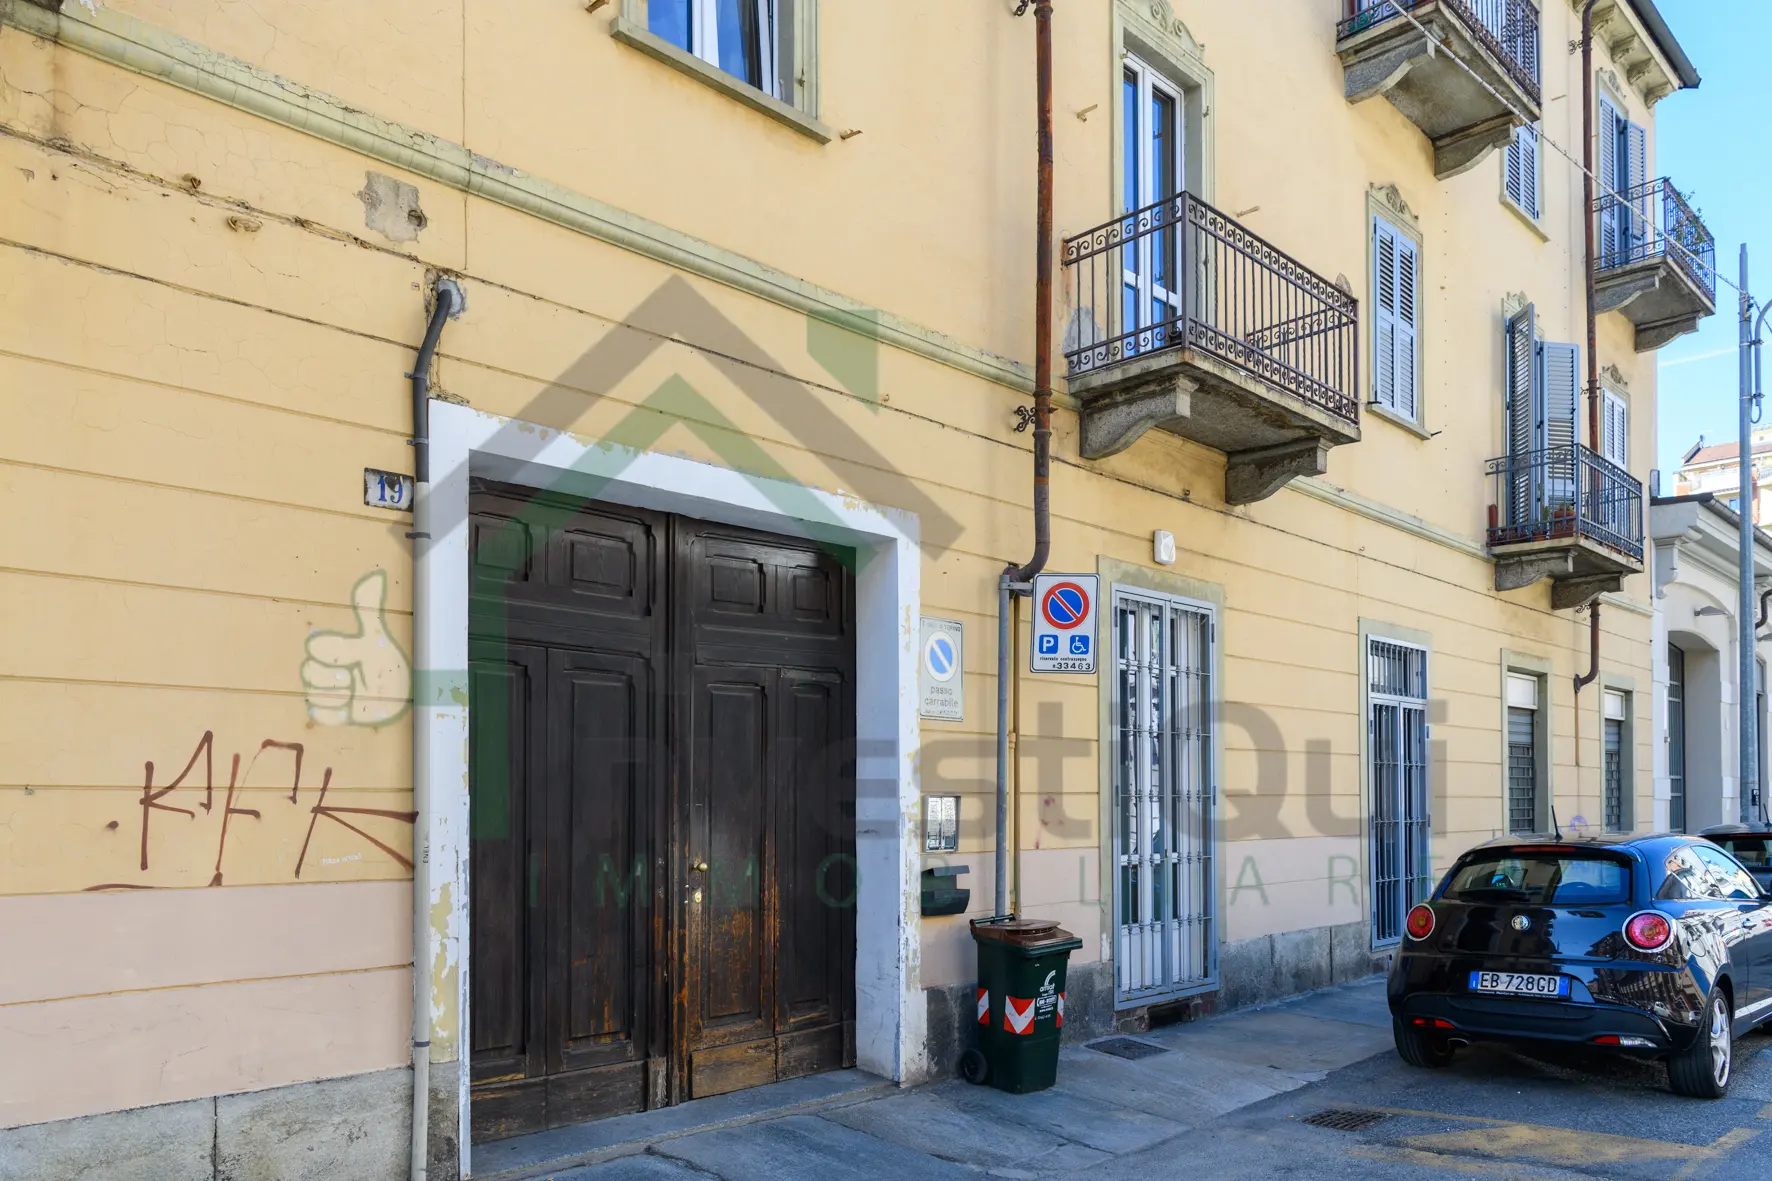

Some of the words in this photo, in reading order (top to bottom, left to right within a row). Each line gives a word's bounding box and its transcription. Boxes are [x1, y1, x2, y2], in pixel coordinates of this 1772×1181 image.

[378, 475, 403, 504] 19
[1042, 636, 1055, 652] P
[930, 686, 953, 695] passo
[924, 697, 959, 707] carrabile
[1480, 973, 1500, 988] EB
[1505, 974, 1557, 992] 728GD
